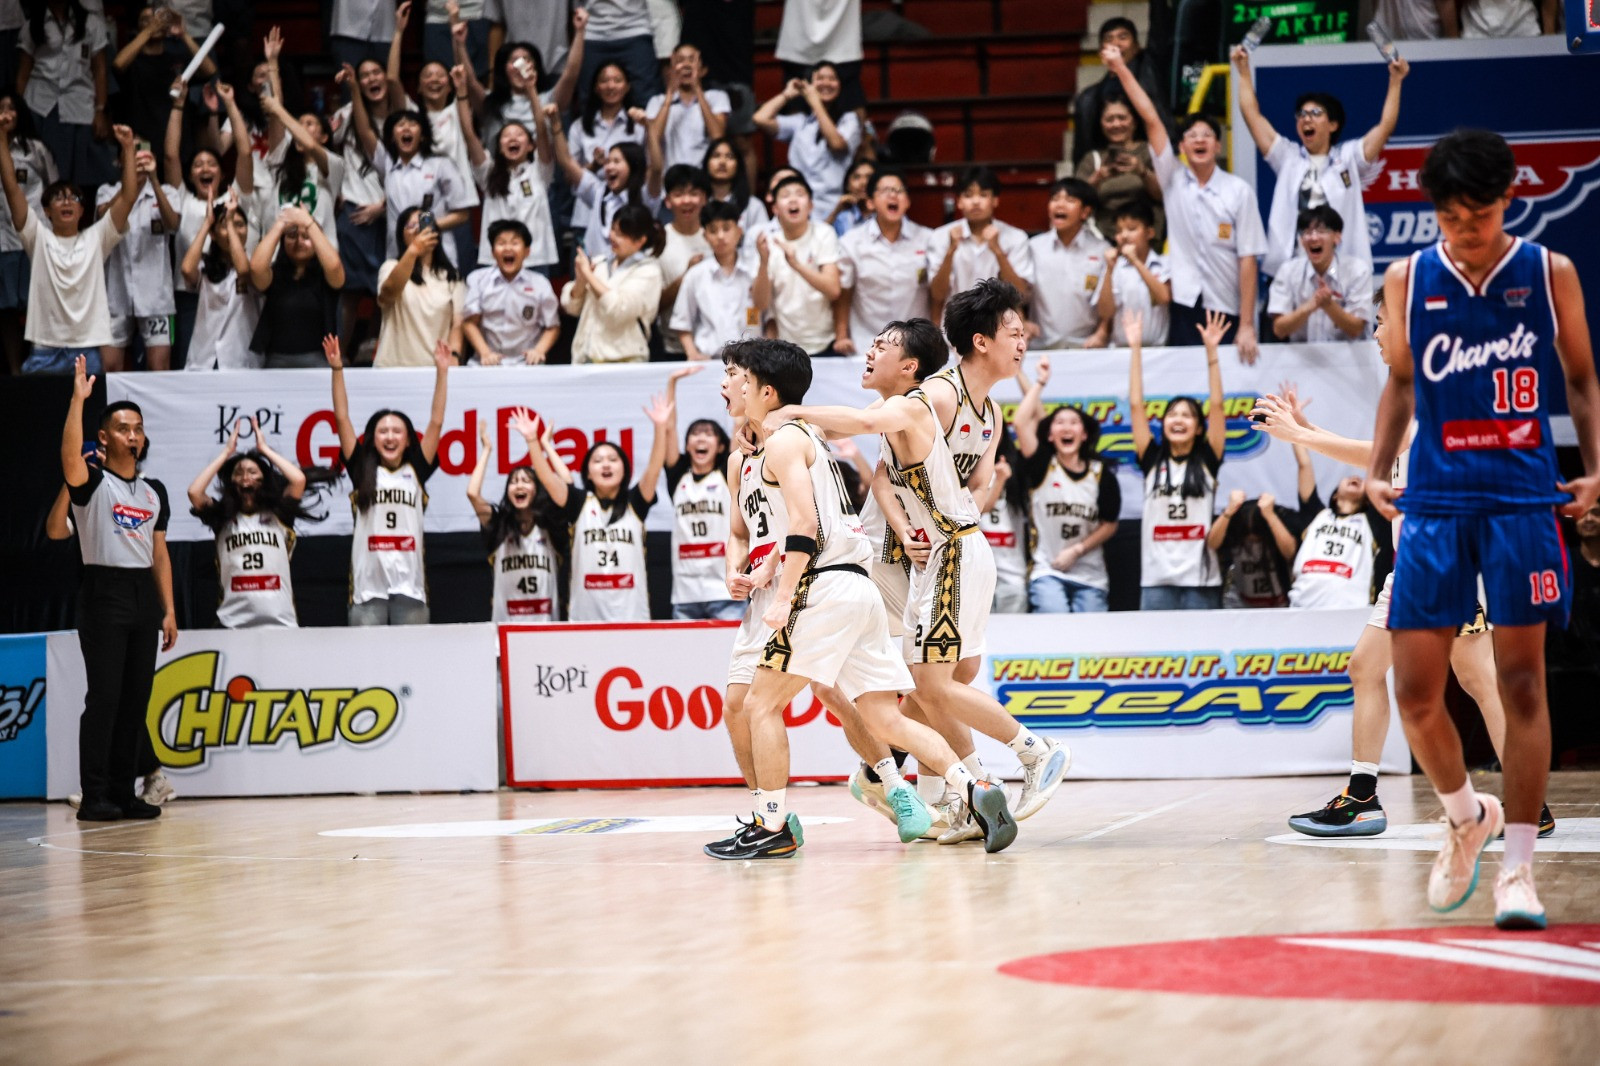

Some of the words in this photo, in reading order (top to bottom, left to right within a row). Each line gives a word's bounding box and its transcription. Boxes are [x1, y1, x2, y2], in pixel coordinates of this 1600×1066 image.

[1275, 11, 1348, 37] AKTIF
[149, 320, 168, 336] 22
[1422, 322, 1538, 382] Charets
[1492, 367, 1539, 413] 18
[386, 512, 397, 529] 9
[1168, 504, 1188, 519] 23
[691, 521, 708, 537] 10
[756, 511, 769, 538] 3
[225, 531, 280, 552] TRIMULIA
[1323, 540, 1345, 556] 33
[242, 552, 264, 570] 29
[597, 550, 619, 567] 34
[517, 576, 538, 594] 45
[1529, 569, 1561, 605] 18
[992, 658, 1075, 681] YANG
[1077, 656, 1184, 679] WORTH
[1187, 656, 1226, 680] IT,
[1233, 654, 1272, 676] YA
[534, 664, 589, 698] Kopi
